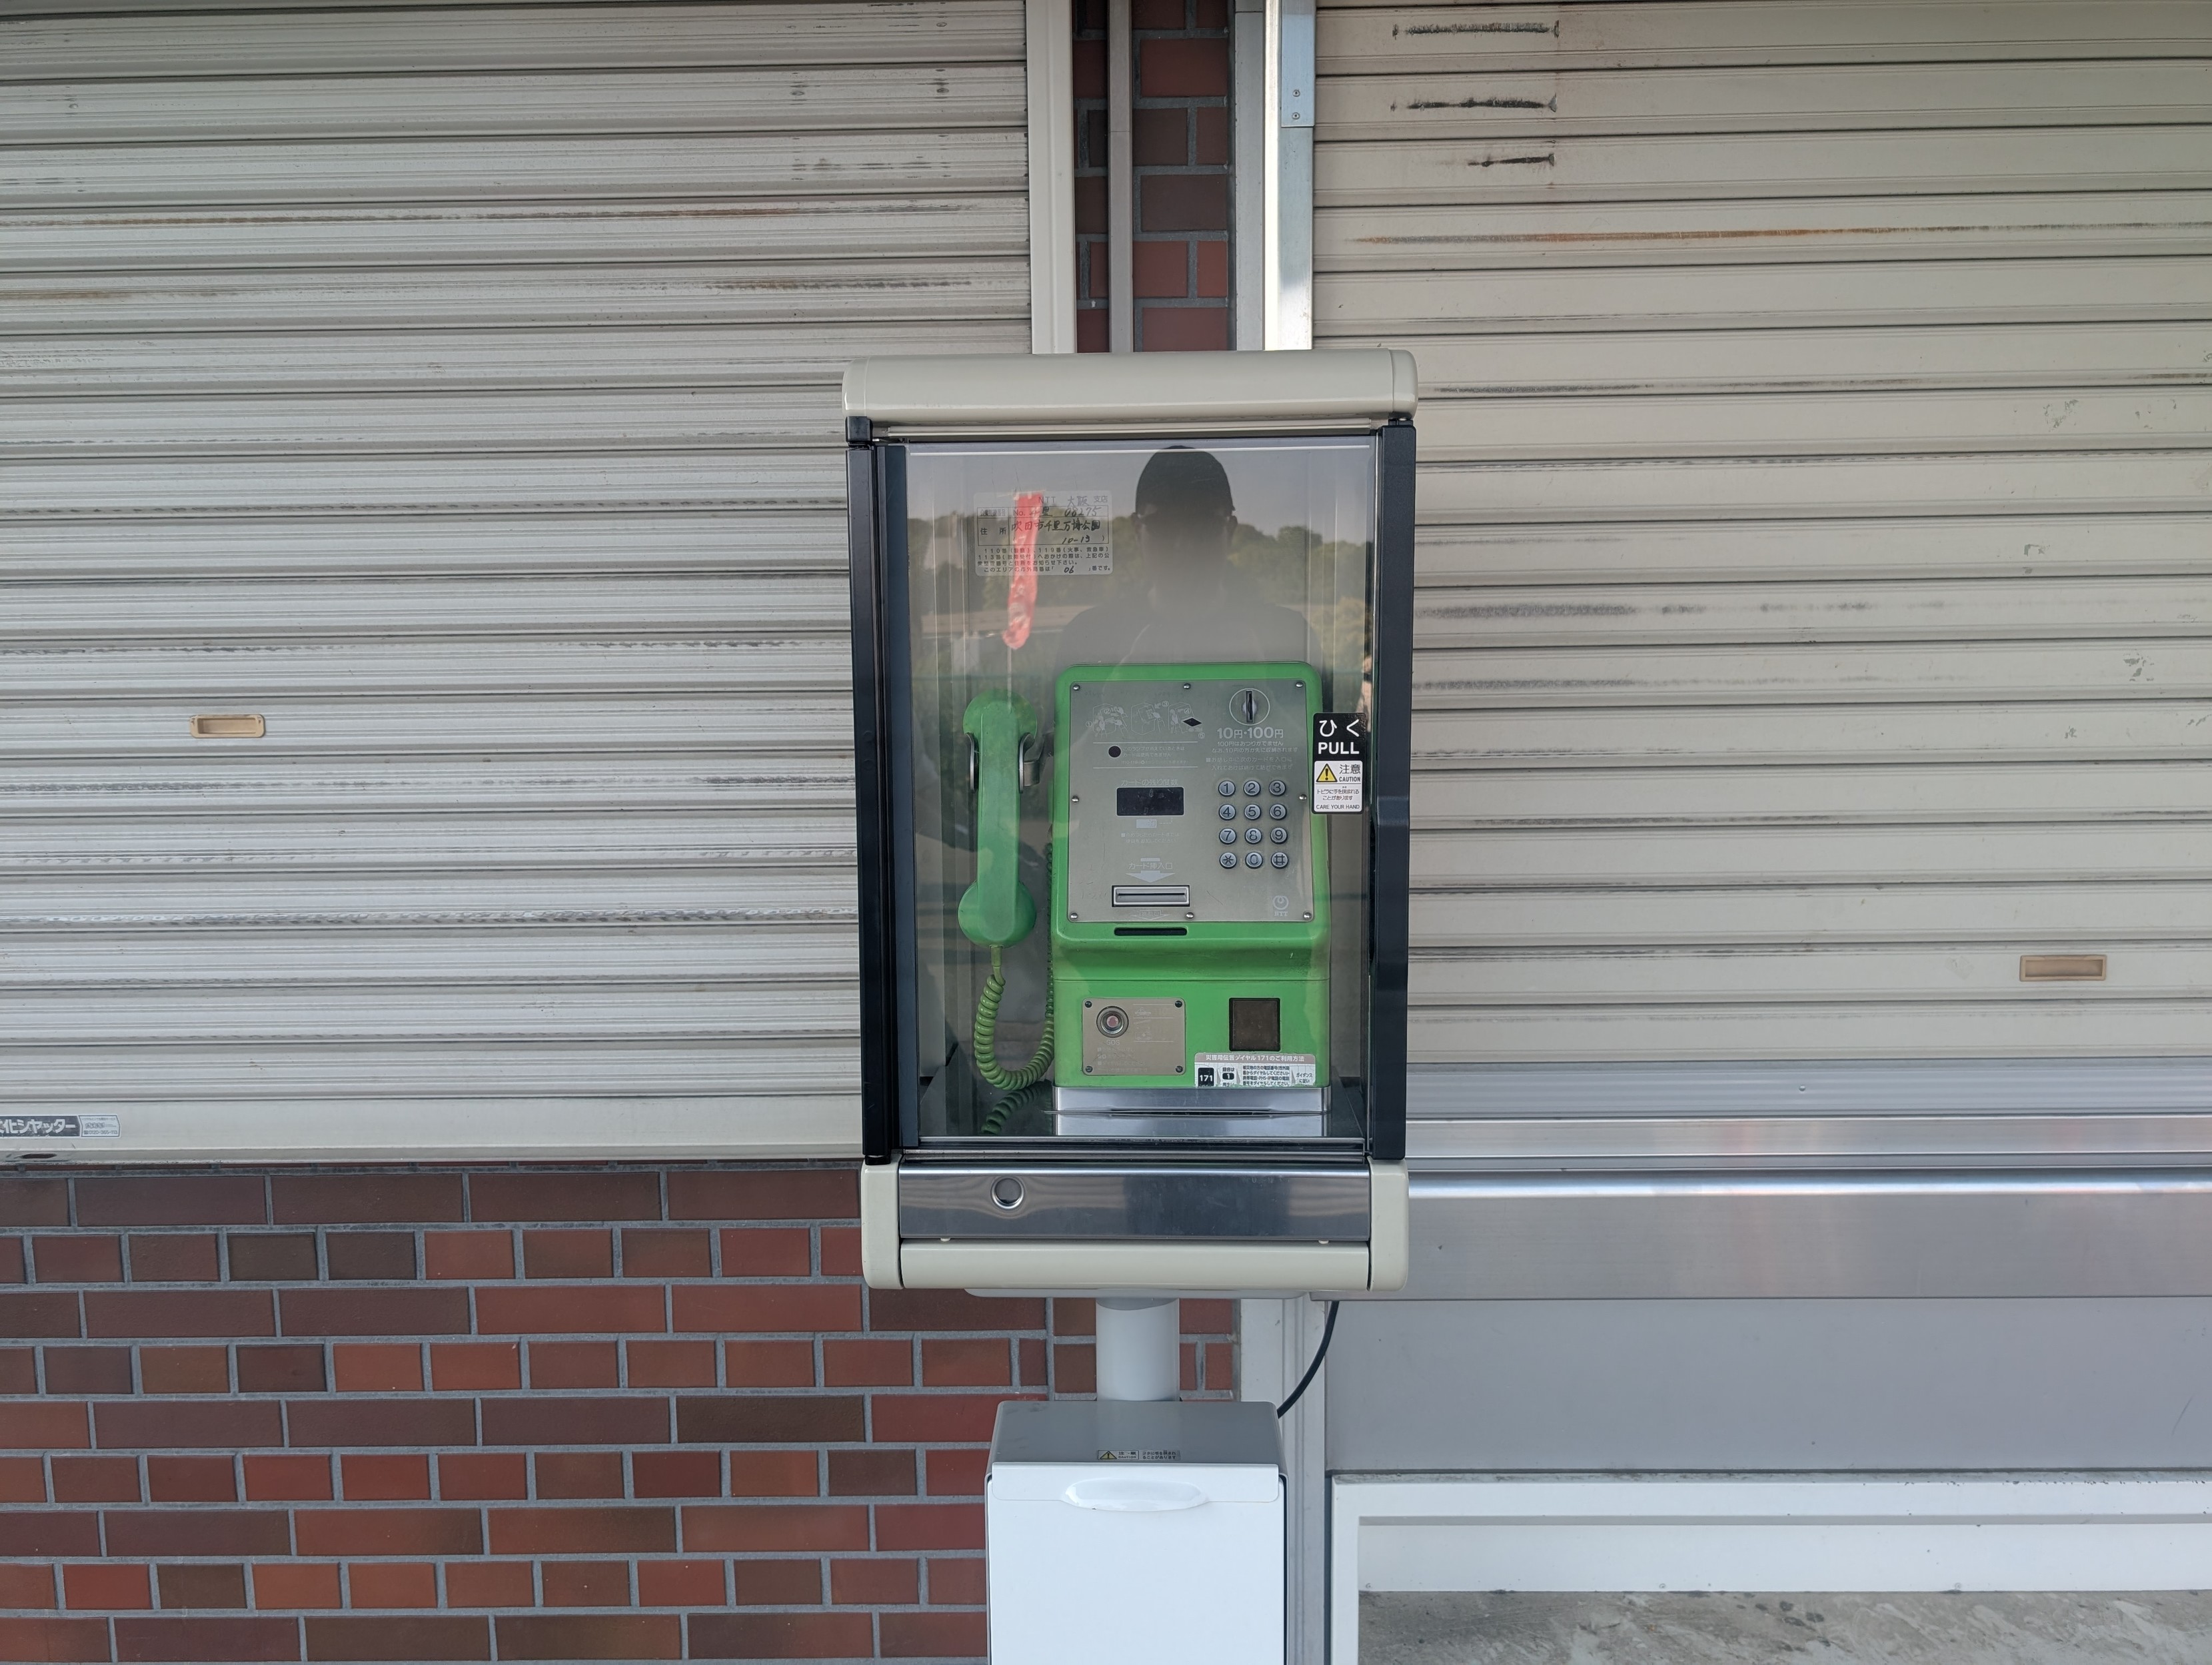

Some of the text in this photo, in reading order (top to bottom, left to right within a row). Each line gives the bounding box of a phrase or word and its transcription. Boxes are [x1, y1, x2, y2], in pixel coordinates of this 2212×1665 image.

[1319, 719, 1360, 738] ひく
[1318, 742, 1360, 754] PULL
[1339, 764, 1361, 774] 注意
[1224, 782, 1281, 793] 1 2 3
[1223, 806, 1282, 817] 4 5 6
[1224, 830, 1283, 841] 7 8 9
[1250, 854, 1285, 865] 0 #
